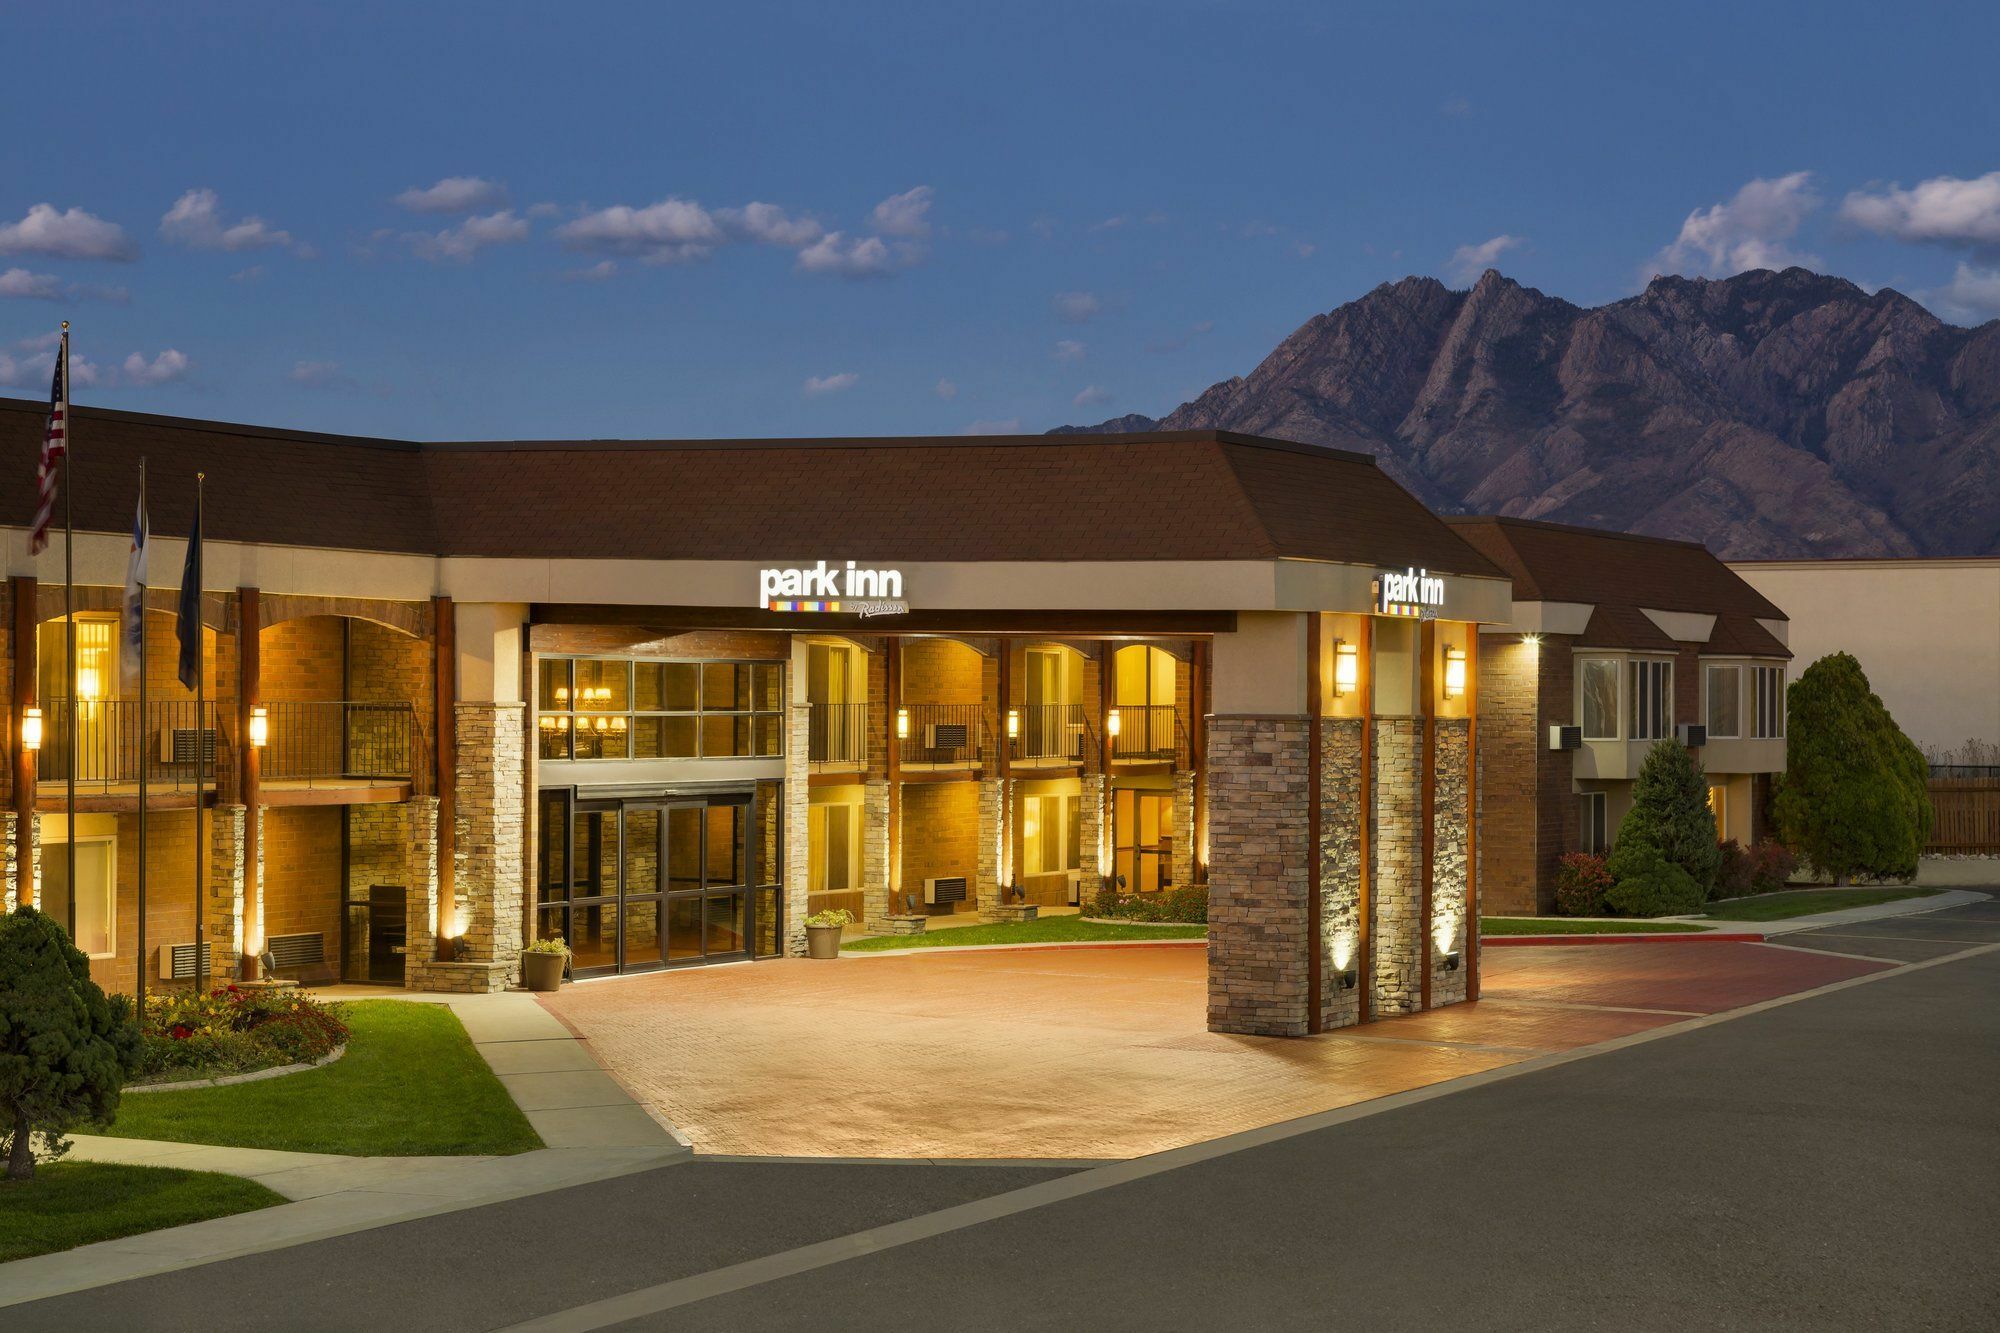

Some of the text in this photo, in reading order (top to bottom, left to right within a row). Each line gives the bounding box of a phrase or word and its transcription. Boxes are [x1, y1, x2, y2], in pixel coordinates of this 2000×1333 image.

[760, 560, 902, 609] park inn
[1384, 567, 1444, 614] park inn
